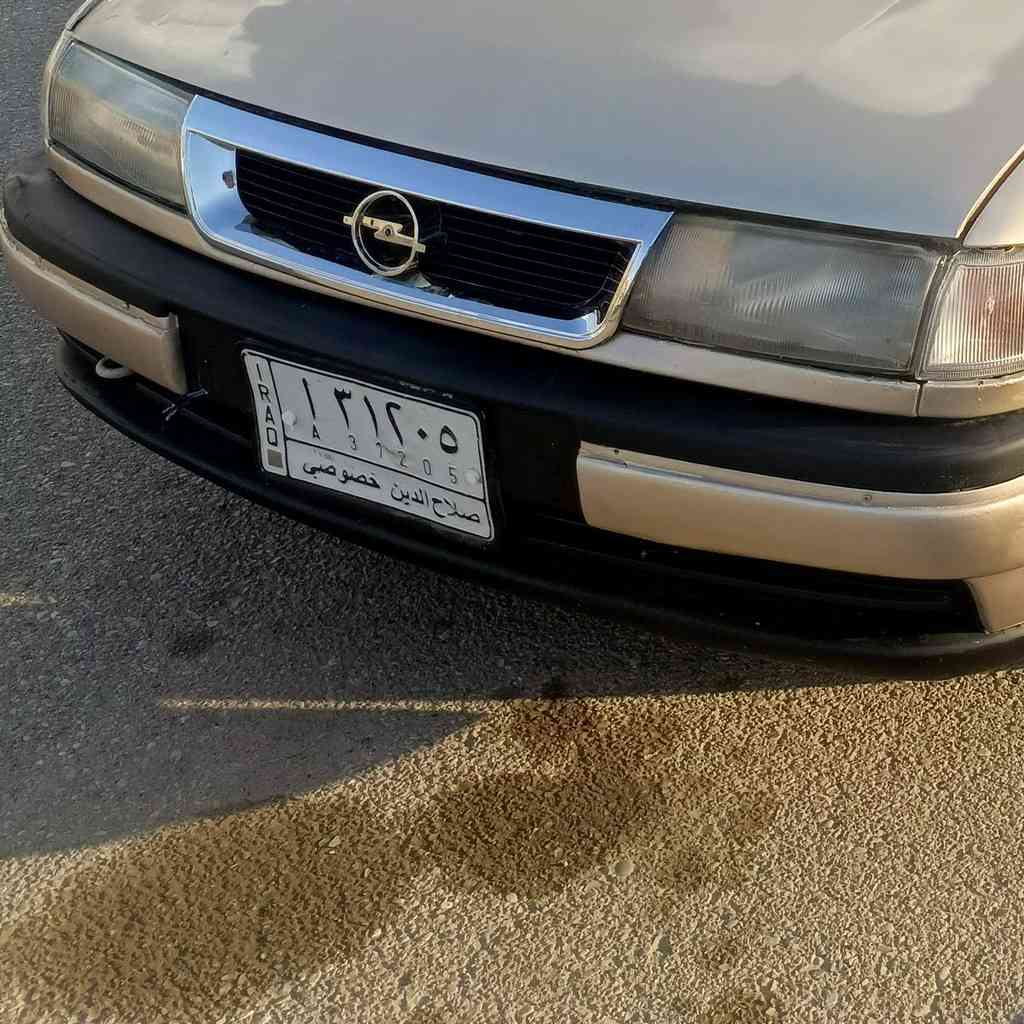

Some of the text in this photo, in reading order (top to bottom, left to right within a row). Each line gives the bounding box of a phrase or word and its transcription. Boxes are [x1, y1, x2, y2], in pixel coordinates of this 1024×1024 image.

[256, 363, 278, 446] IRAQ
[390, 483, 429, 505] الدين
[430, 496, 481, 524] صلاح
